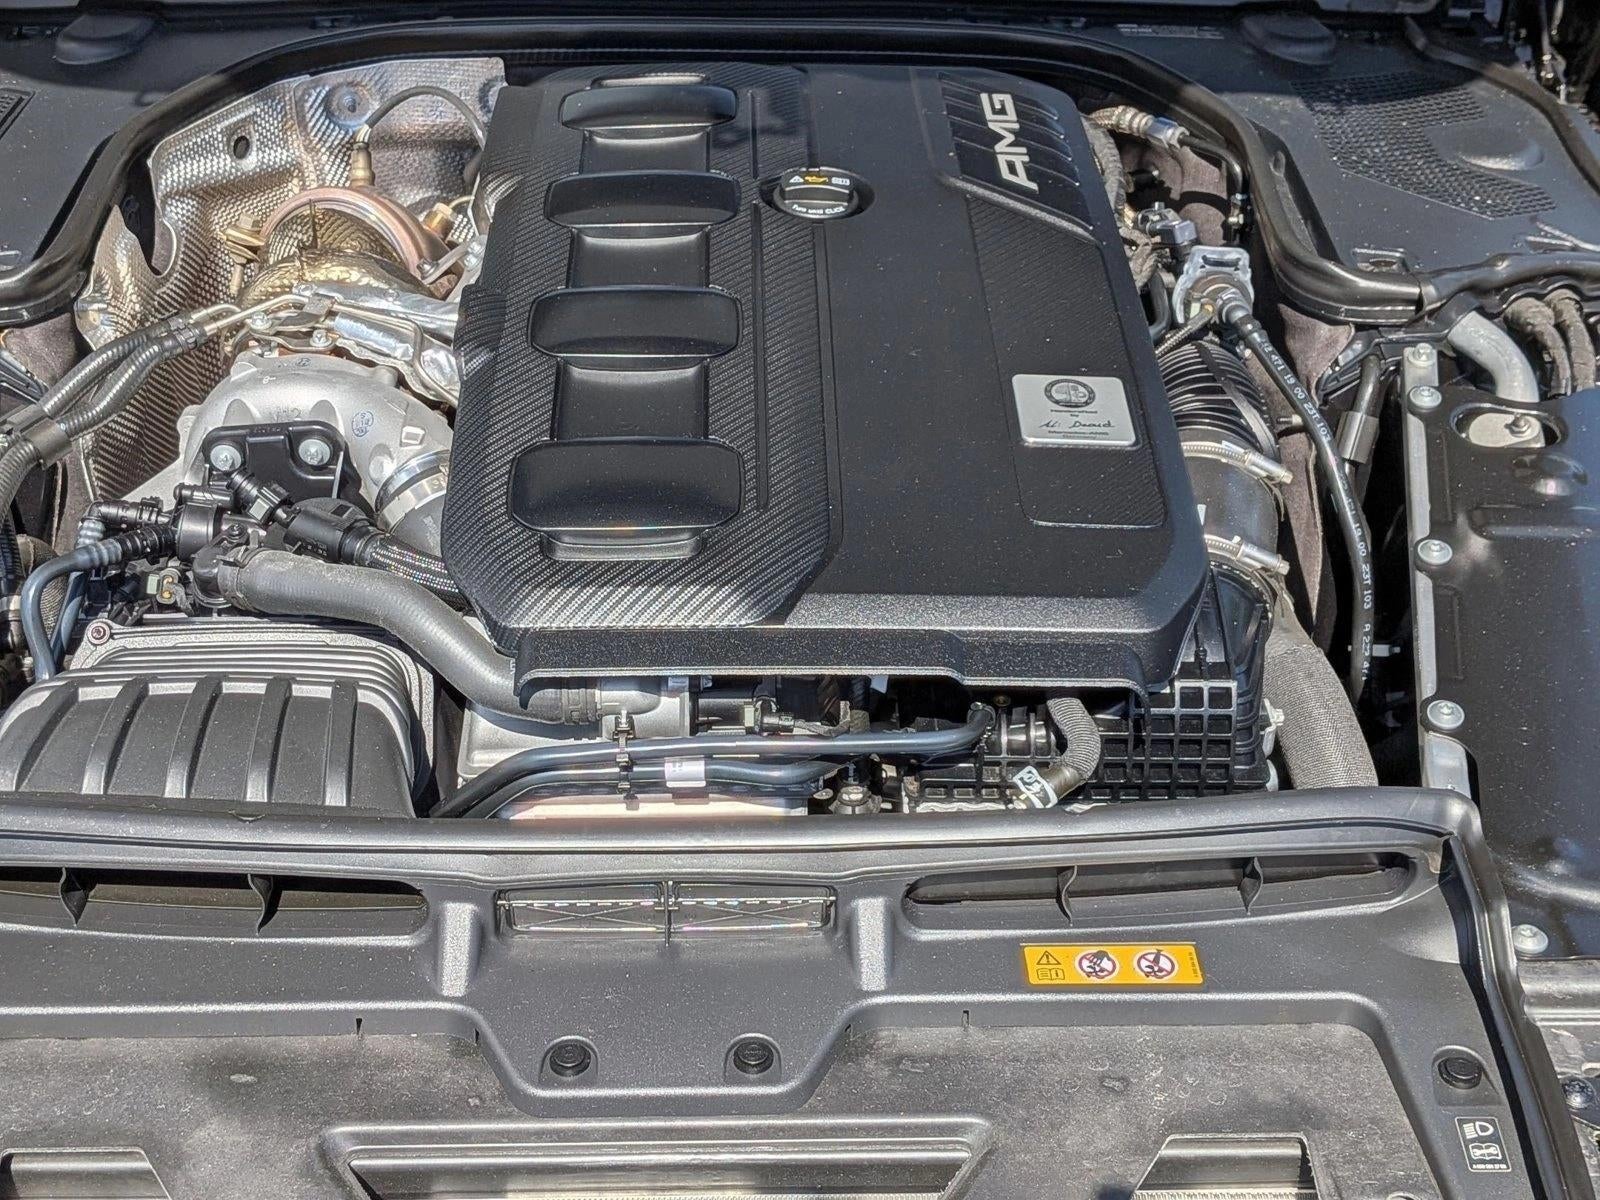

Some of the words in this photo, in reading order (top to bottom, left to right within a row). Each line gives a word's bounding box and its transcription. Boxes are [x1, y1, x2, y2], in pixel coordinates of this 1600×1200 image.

[980, 93, 1039, 194] AMG
[1294, 387, 1306, 399] 00
[1304, 402, 1320, 421] 23T
[1362, 563, 1372, 586] 23T
[1363, 590, 1373, 610] 103
